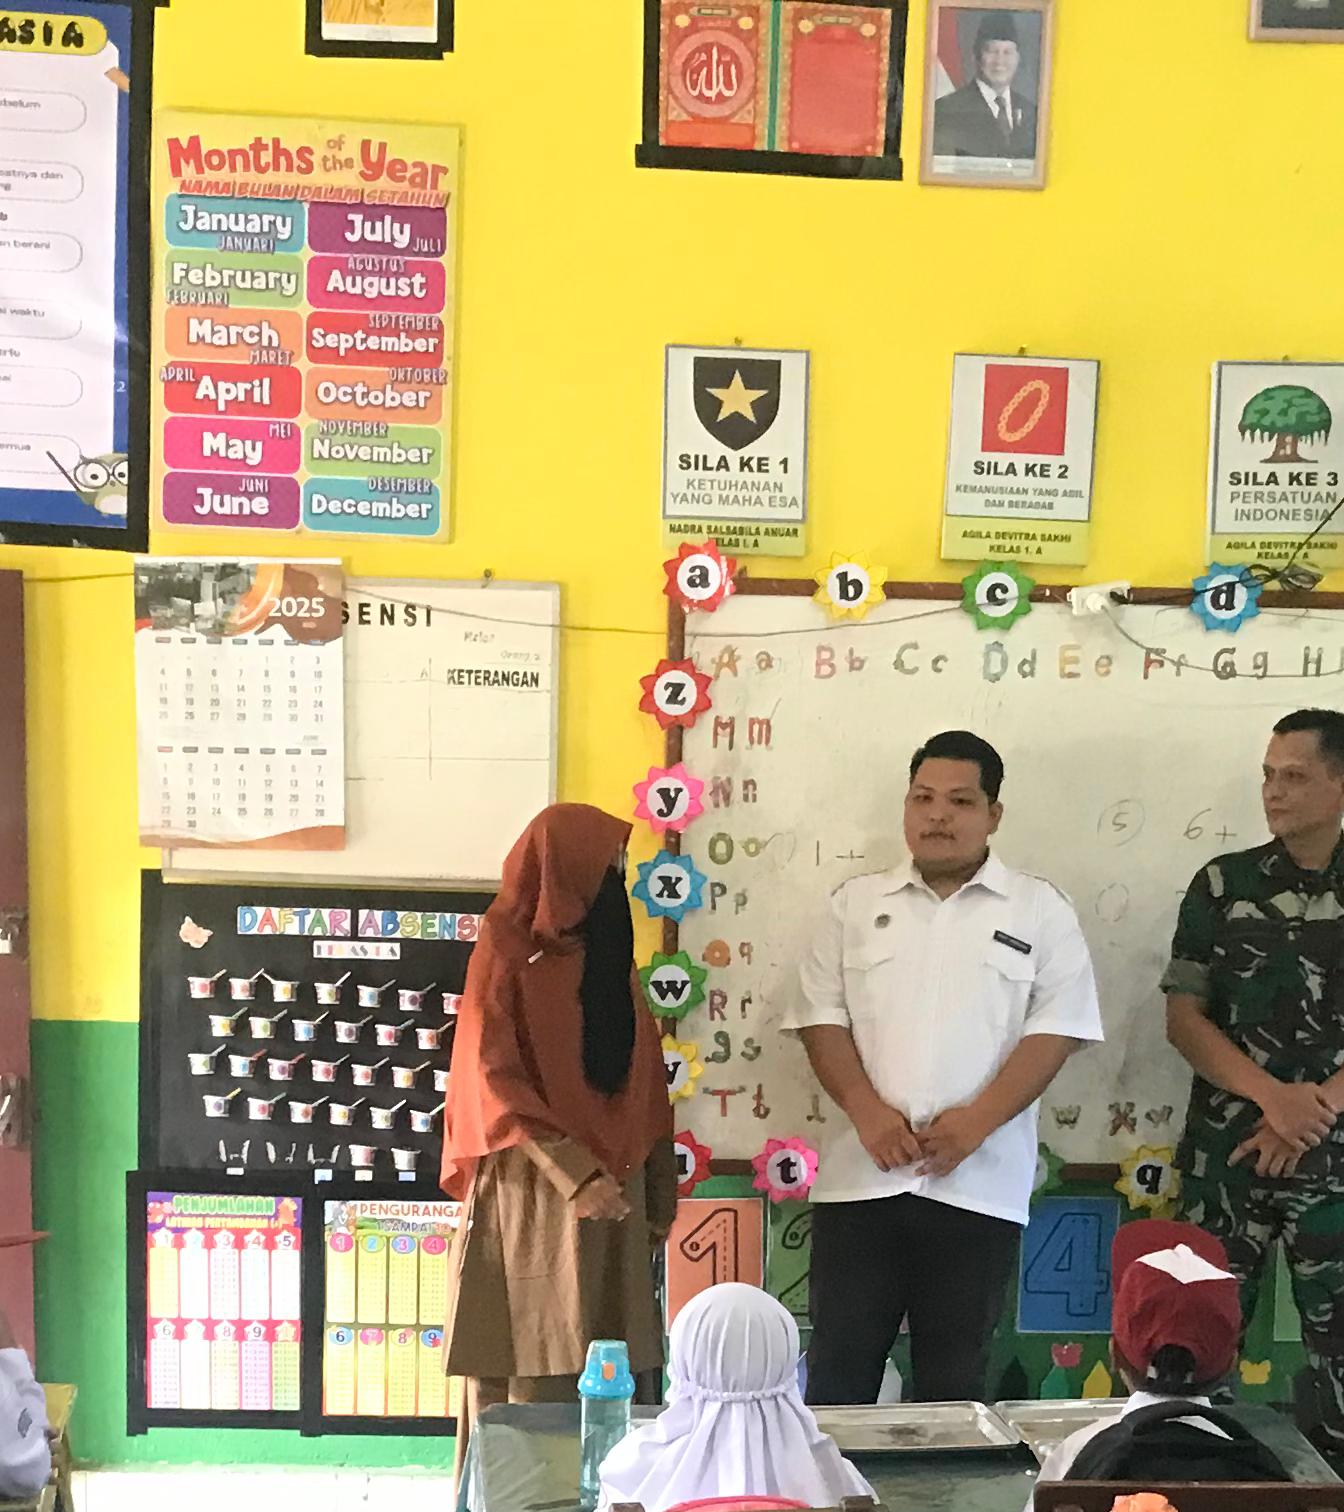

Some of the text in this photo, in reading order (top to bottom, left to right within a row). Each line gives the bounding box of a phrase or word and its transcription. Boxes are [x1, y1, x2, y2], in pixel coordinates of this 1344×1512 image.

[61, 21, 84, 48] A
[167, 135, 448, 190] Months of the Year
[178, 180, 447, 207] NAMA BULAN DALAM SETAHUN
[179, 205, 292, 239] January
[345, 214, 441, 252] July JULI
[218, 237, 275, 254] JANUARI
[348, 256, 405, 271] AGUSTUS
[172, 263, 297, 295] February
[327, 270, 426, 298] August
[167, 289, 229, 305] FEBRUARI
[188, 318, 279, 347] March
[368, 313, 439, 331] SEPTEMBER
[312, 329, 438, 356] September
[249, 350, 292, 365] MARET
[389, 368, 447, 384] OKTOBER
[160, 367, 270, 411] APRIL April
[317, 382, 430, 409] October
[269, 423, 291, 437] MEI
[319, 421, 388, 436] NOVEMBER
[203, 432, 262, 465] May
[313, 439, 432, 464] November
[679, 454, 788, 473] SILA KE 1
[974, 461, 1069, 479] SILA KE 2
[239, 479, 268, 492] JUNI
[368, 477, 431, 494] DESEMBER
[687, 479, 783, 492] KETUHANAN
[1229, 472, 1338, 486] SILA KE 3
[194, 487, 269, 515] June
[671, 492, 799, 508] YANG MAHA ESA
[956, 485, 1084, 498] KEMANUSIAAN YANG ADIL
[1230, 491, 1336, 503] PERSATUAN
[312, 494, 431, 520] December
[985, 499, 1054, 510] DAN BERADAB
[1235, 509, 1332, 521] INDONESIA
[669, 524, 703, 534] NADRA
[687, 565, 710, 588] a
[837, 574, 863, 600] b
[986, 584, 1010, 605] c
[1210, 583, 1235, 612] d
[269, 597, 325, 618] 2025
[447, 669, 539, 688] KETERANGAN
[664, 680, 687, 707] z
[656, 786, 683, 818] y
[656, 875, 683, 899] x
[238, 907, 350, 935] DAFTAR
[651, 979, 690, 1002] w
[776, 1156, 797, 1184] t
[1136, 1165, 1164, 1193] q
[679, 1207, 738, 1285] 1
[1024, 1212, 1110, 1317] 4
